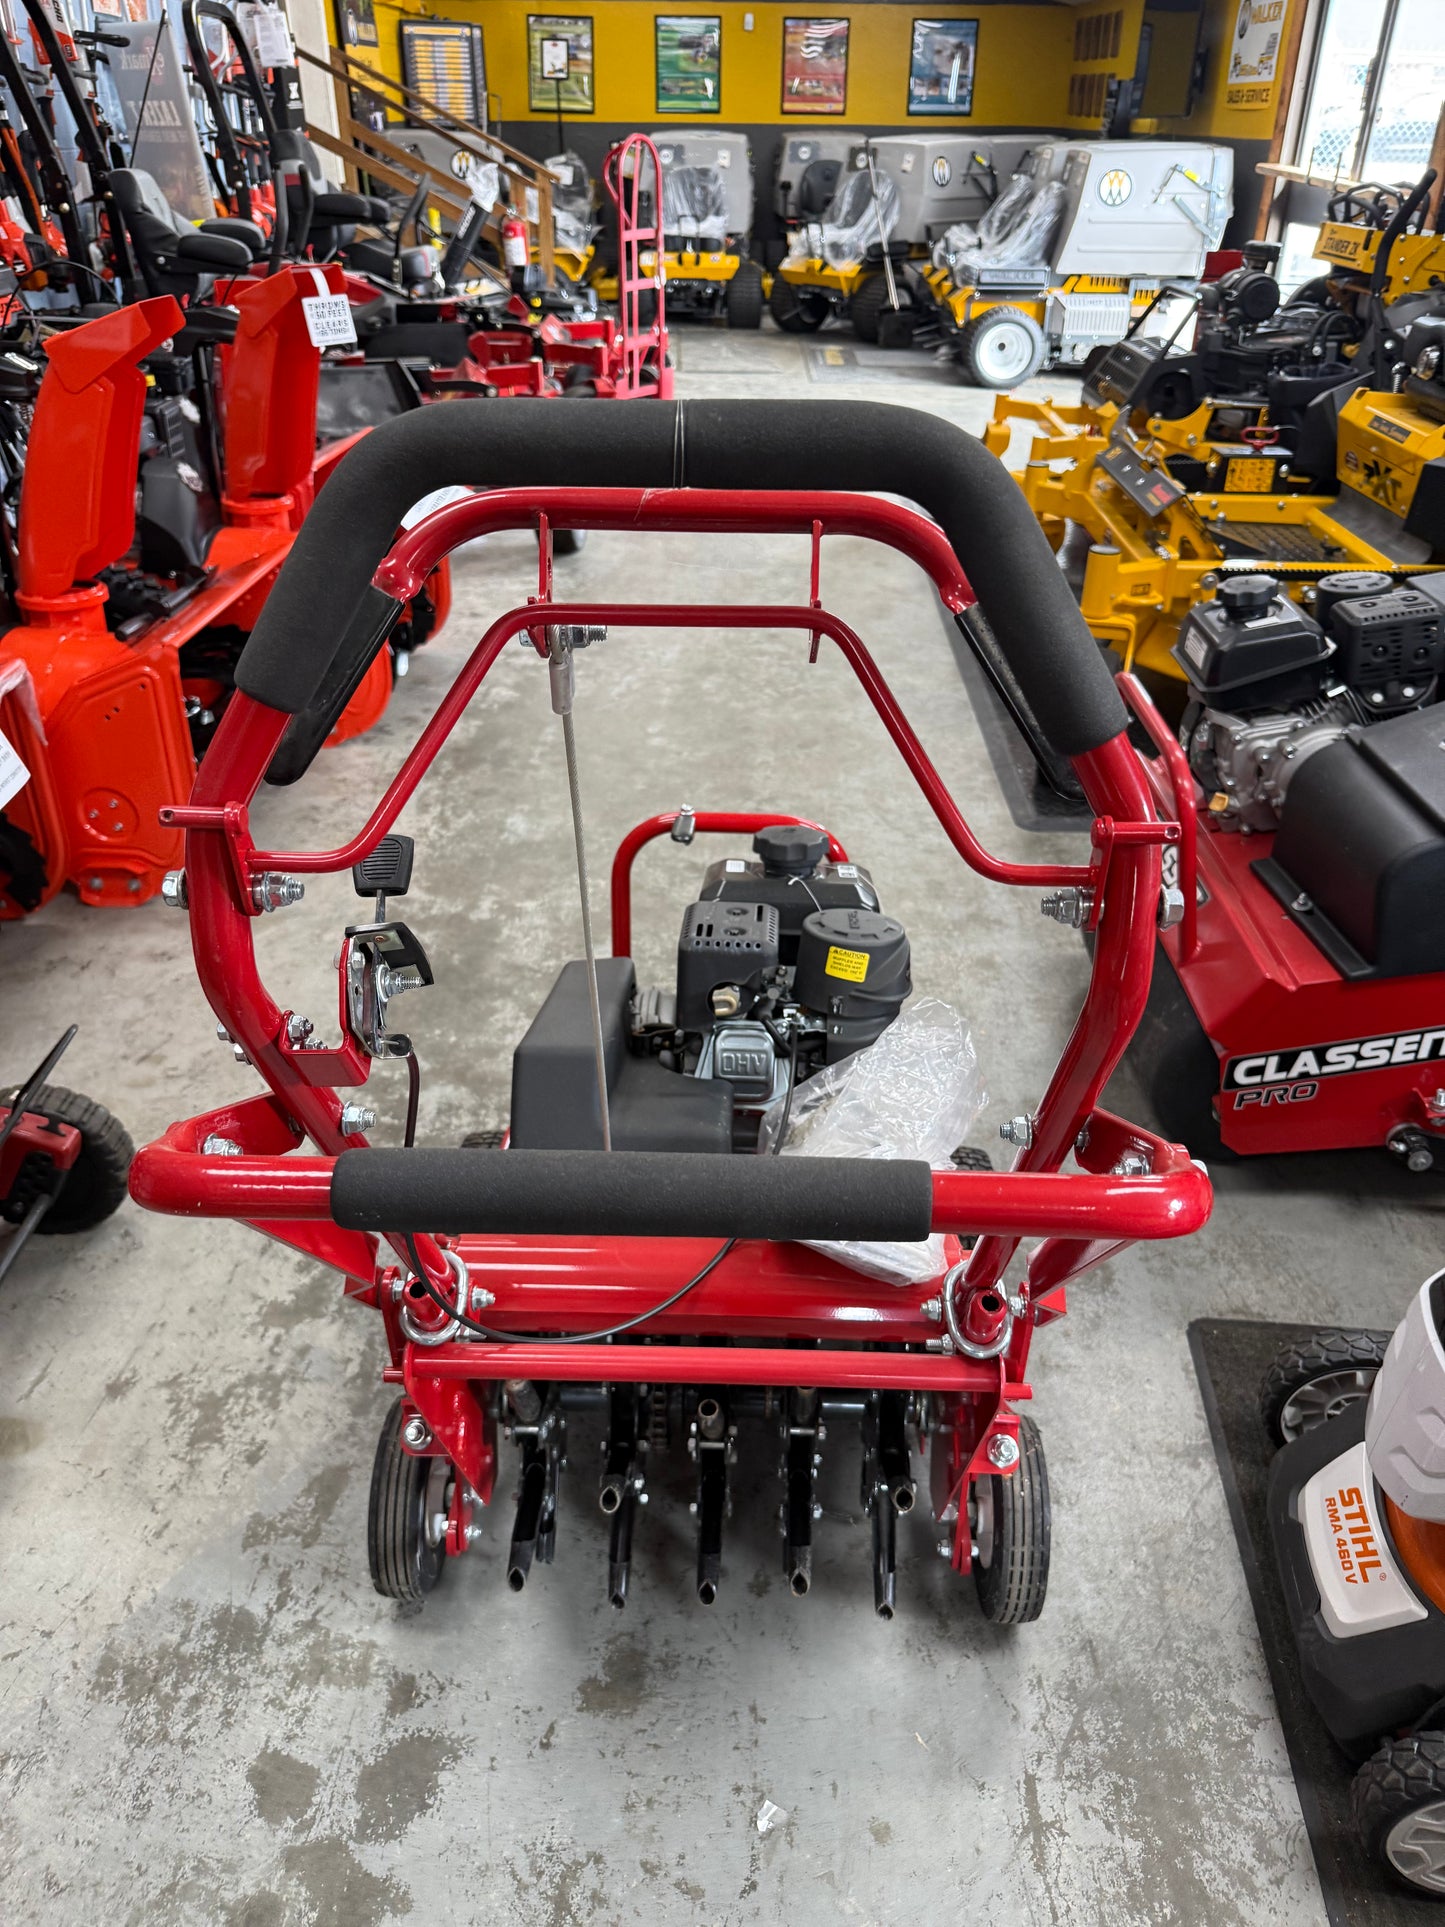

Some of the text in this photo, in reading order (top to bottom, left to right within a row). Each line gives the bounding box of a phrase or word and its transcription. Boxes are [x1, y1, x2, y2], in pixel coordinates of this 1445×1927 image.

[838, 949, 866, 959] CAUTION
[722, 1052, 767, 1073] OHV
[1233, 1081, 1319, 1110] PRO
[1325, 1497, 1343, 1534] RMA
[1336, 1537, 1354, 1571] 460
[1338, 1487, 1382, 1583] STIHL
